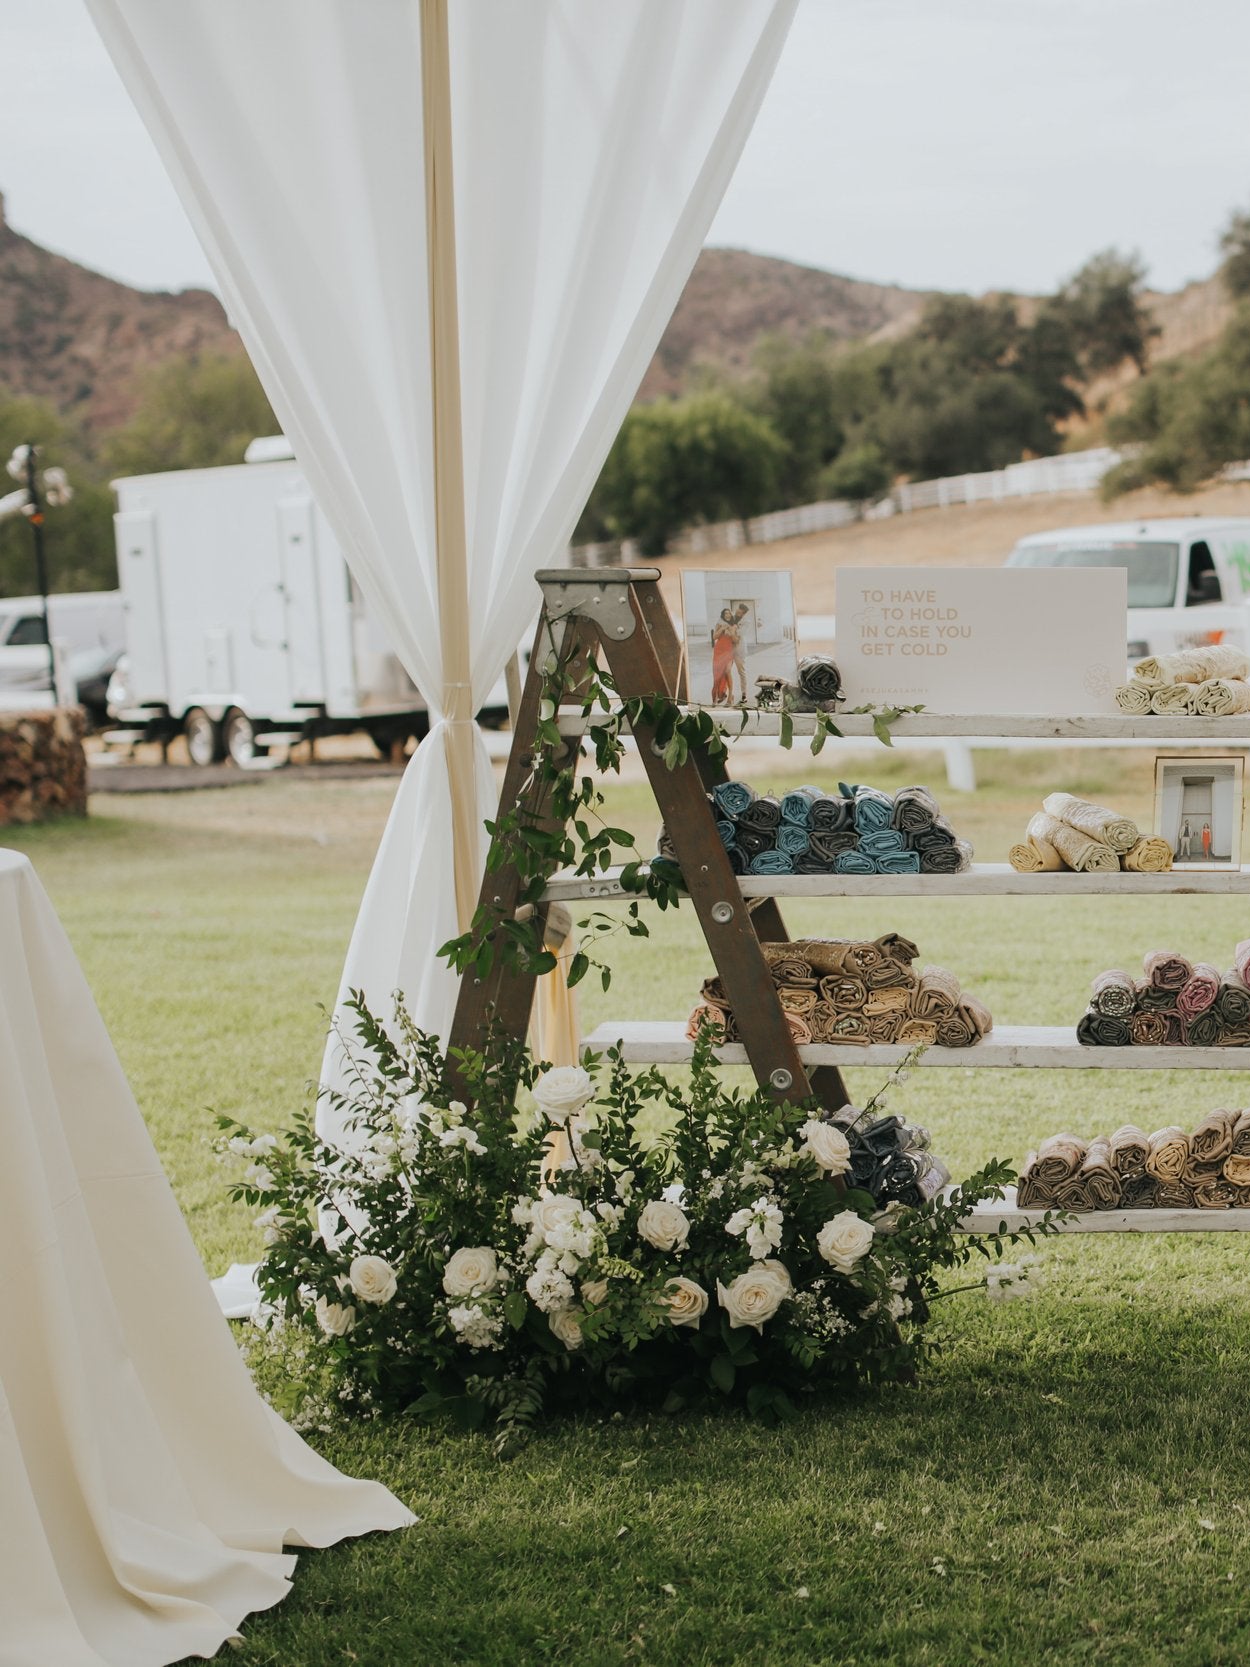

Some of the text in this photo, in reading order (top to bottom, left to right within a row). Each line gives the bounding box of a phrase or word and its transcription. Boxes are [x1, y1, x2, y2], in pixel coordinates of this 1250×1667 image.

[861, 590, 936, 603] TO HAVE
[881, 607, 904, 620] TO
[910, 607, 958, 620] HOLD
[862, 625, 971, 638] IN CASE YOU
[861, 643, 948, 656] GET COLD
